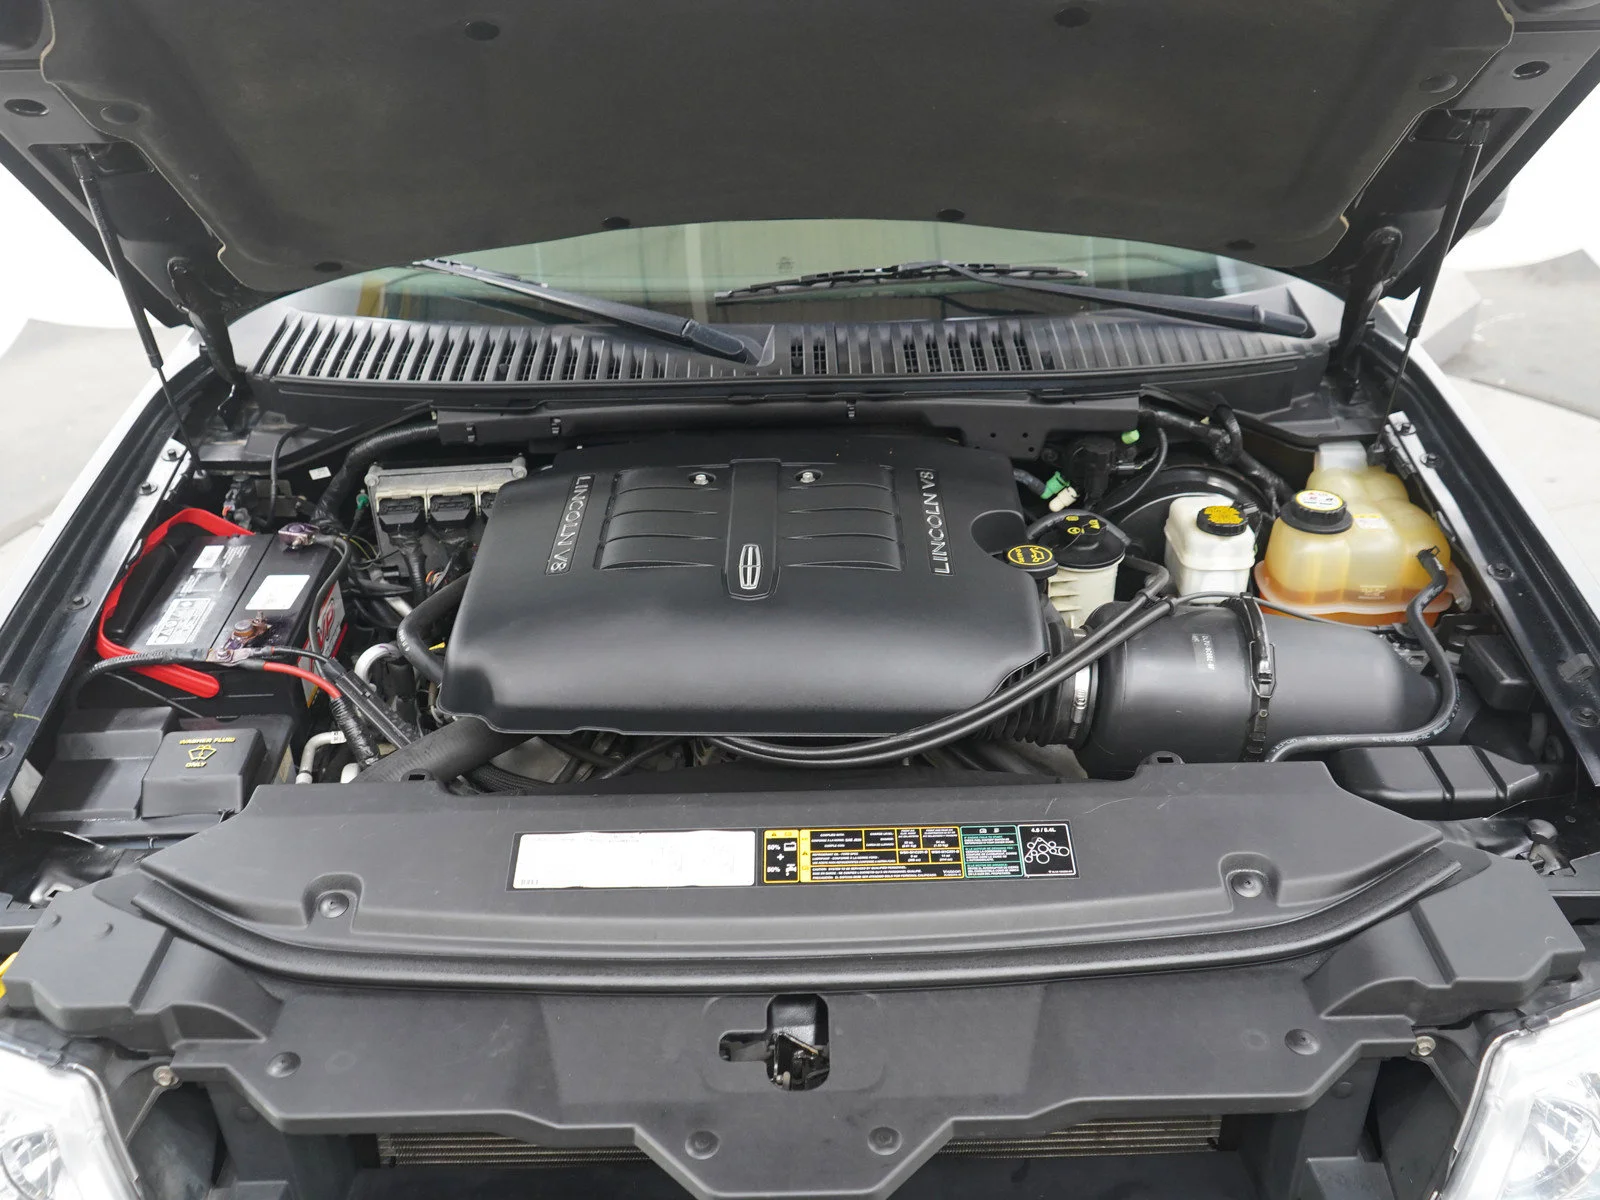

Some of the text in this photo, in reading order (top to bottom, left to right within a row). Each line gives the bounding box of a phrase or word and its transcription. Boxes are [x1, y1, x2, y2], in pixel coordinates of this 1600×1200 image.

[550, 475, 592, 573] LINCOLN V8
[919, 471, 951, 575] LINCOLN V8
[180, 737, 213, 745] WASHER
